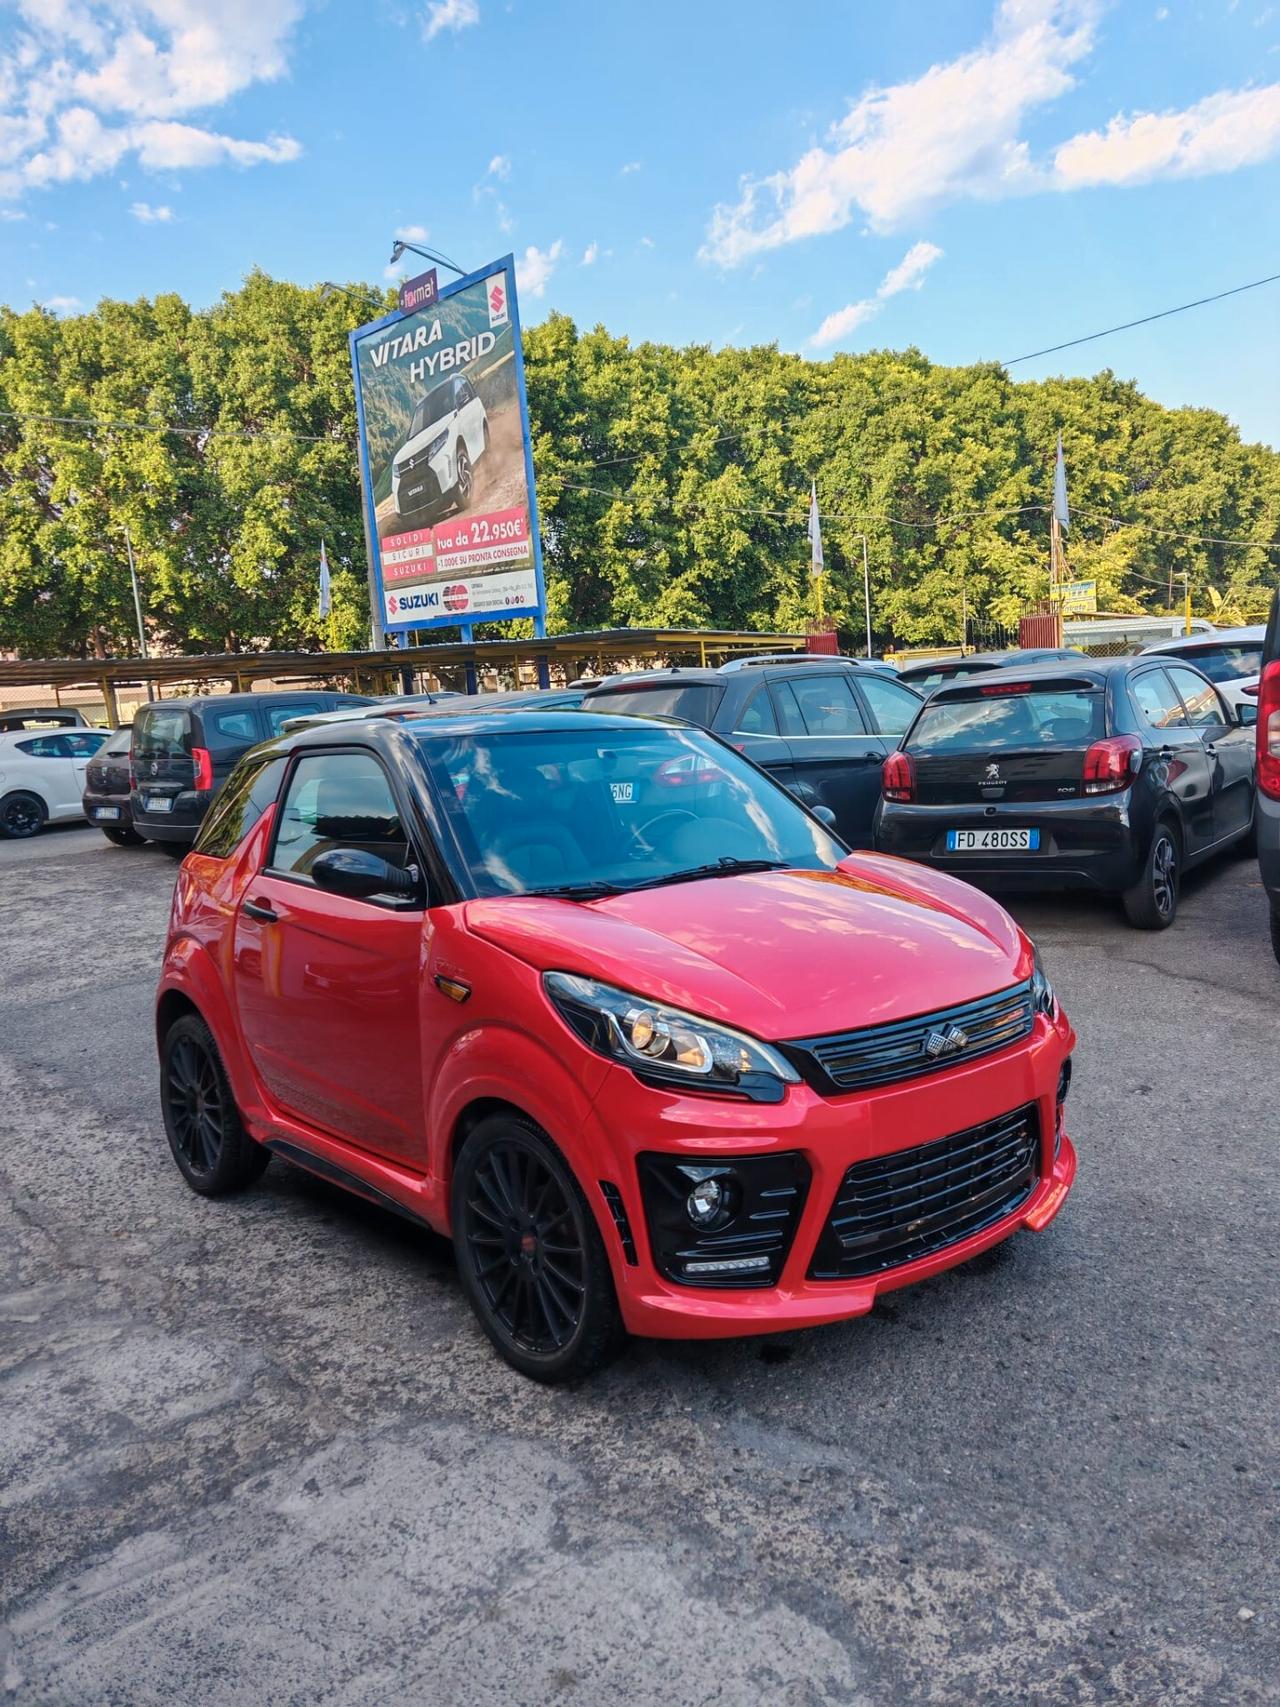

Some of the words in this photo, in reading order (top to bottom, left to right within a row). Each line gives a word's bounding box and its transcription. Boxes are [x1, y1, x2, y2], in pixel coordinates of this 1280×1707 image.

[369, 318, 443, 368] VITARA
[410, 331, 496, 384] HYBRID
[390, 534, 424, 547] SOLIDI
[437, 537, 453, 550] tua
[455, 530, 469, 546] da
[391, 547, 425, 561] SICURI
[459, 555, 468, 566] SU
[468, 551, 492, 564] PRONTA
[492, 545, 529, 560] CONSEGNA
[392, 561, 427, 576] SUZUKI
[399, 592, 439, 611] SUZUKI
[957, 831, 976, 848] FD
[981, 831, 1028, 848] 480SS
